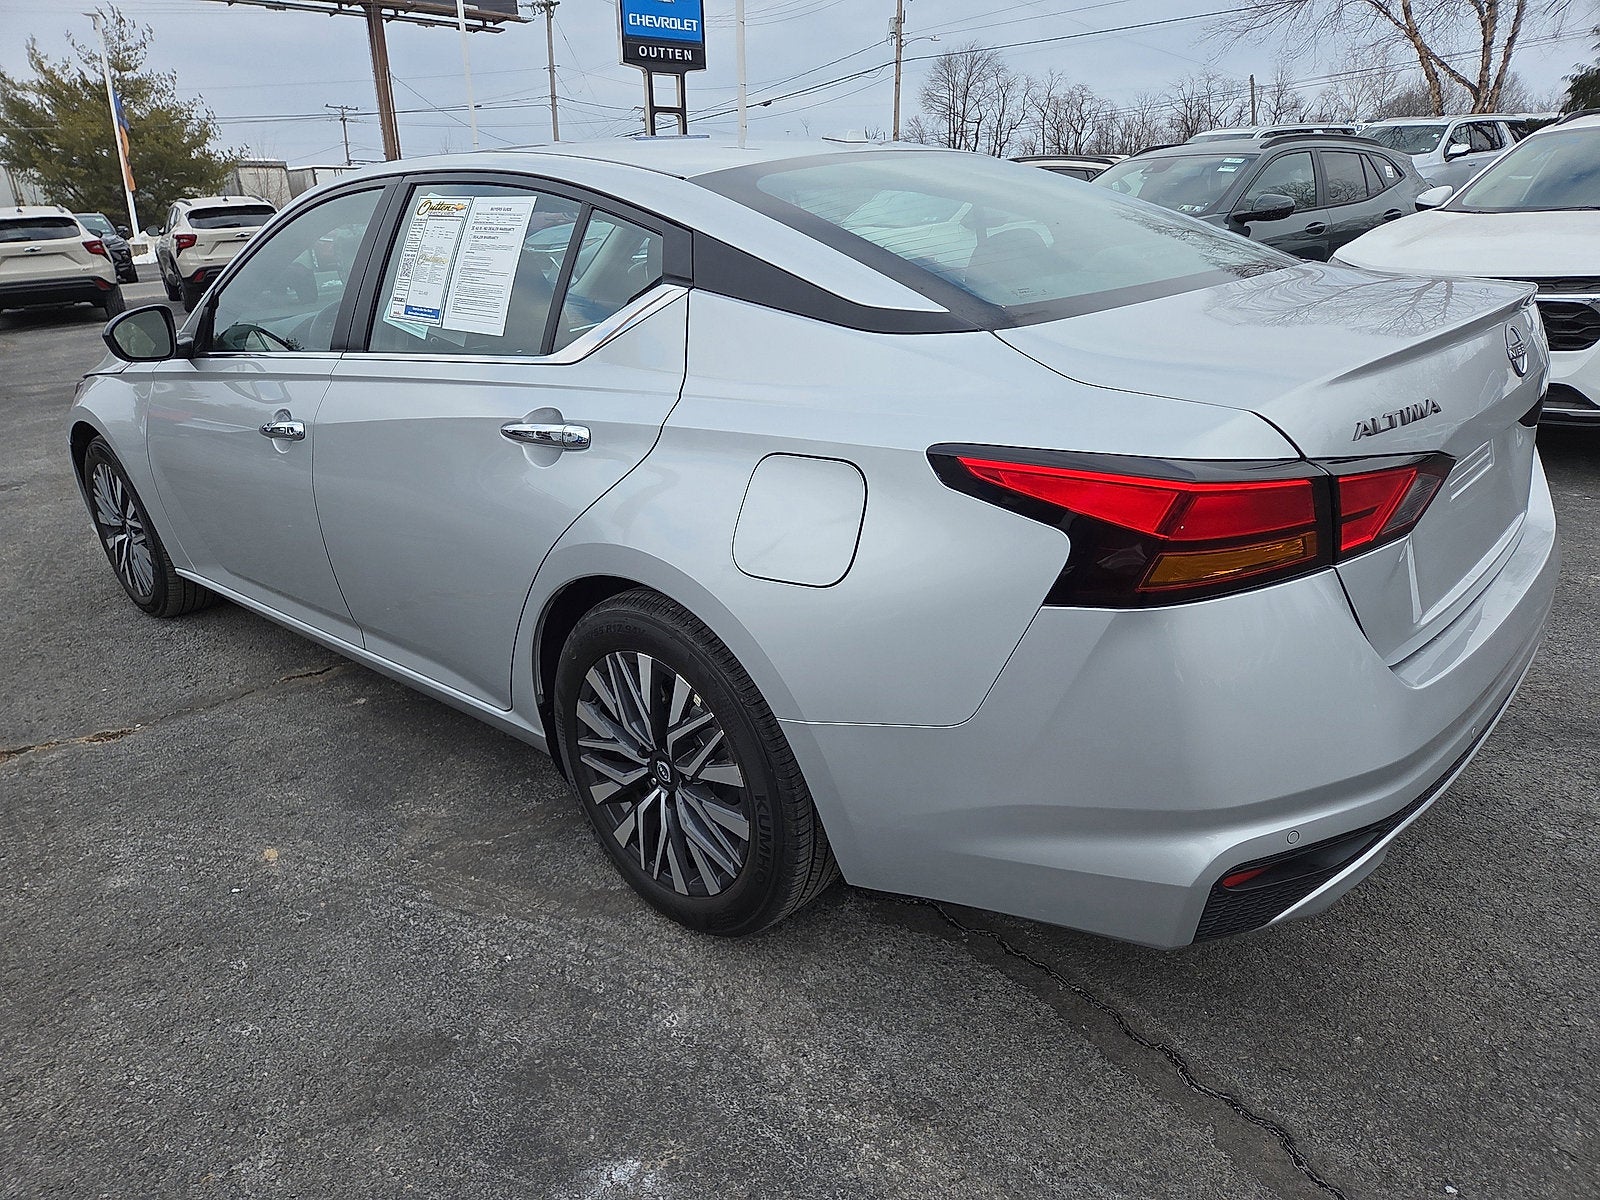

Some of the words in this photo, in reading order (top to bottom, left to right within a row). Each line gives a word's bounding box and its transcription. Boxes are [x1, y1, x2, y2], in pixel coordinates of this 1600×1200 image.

[628, 13, 698, 32] CHEVROLET
[638, 45, 692, 60] OUTTEN
[417, 199, 453, 216] Outten
[1352, 399, 1442, 441] ALTIMA
[754, 793, 771, 884] KUMHO
